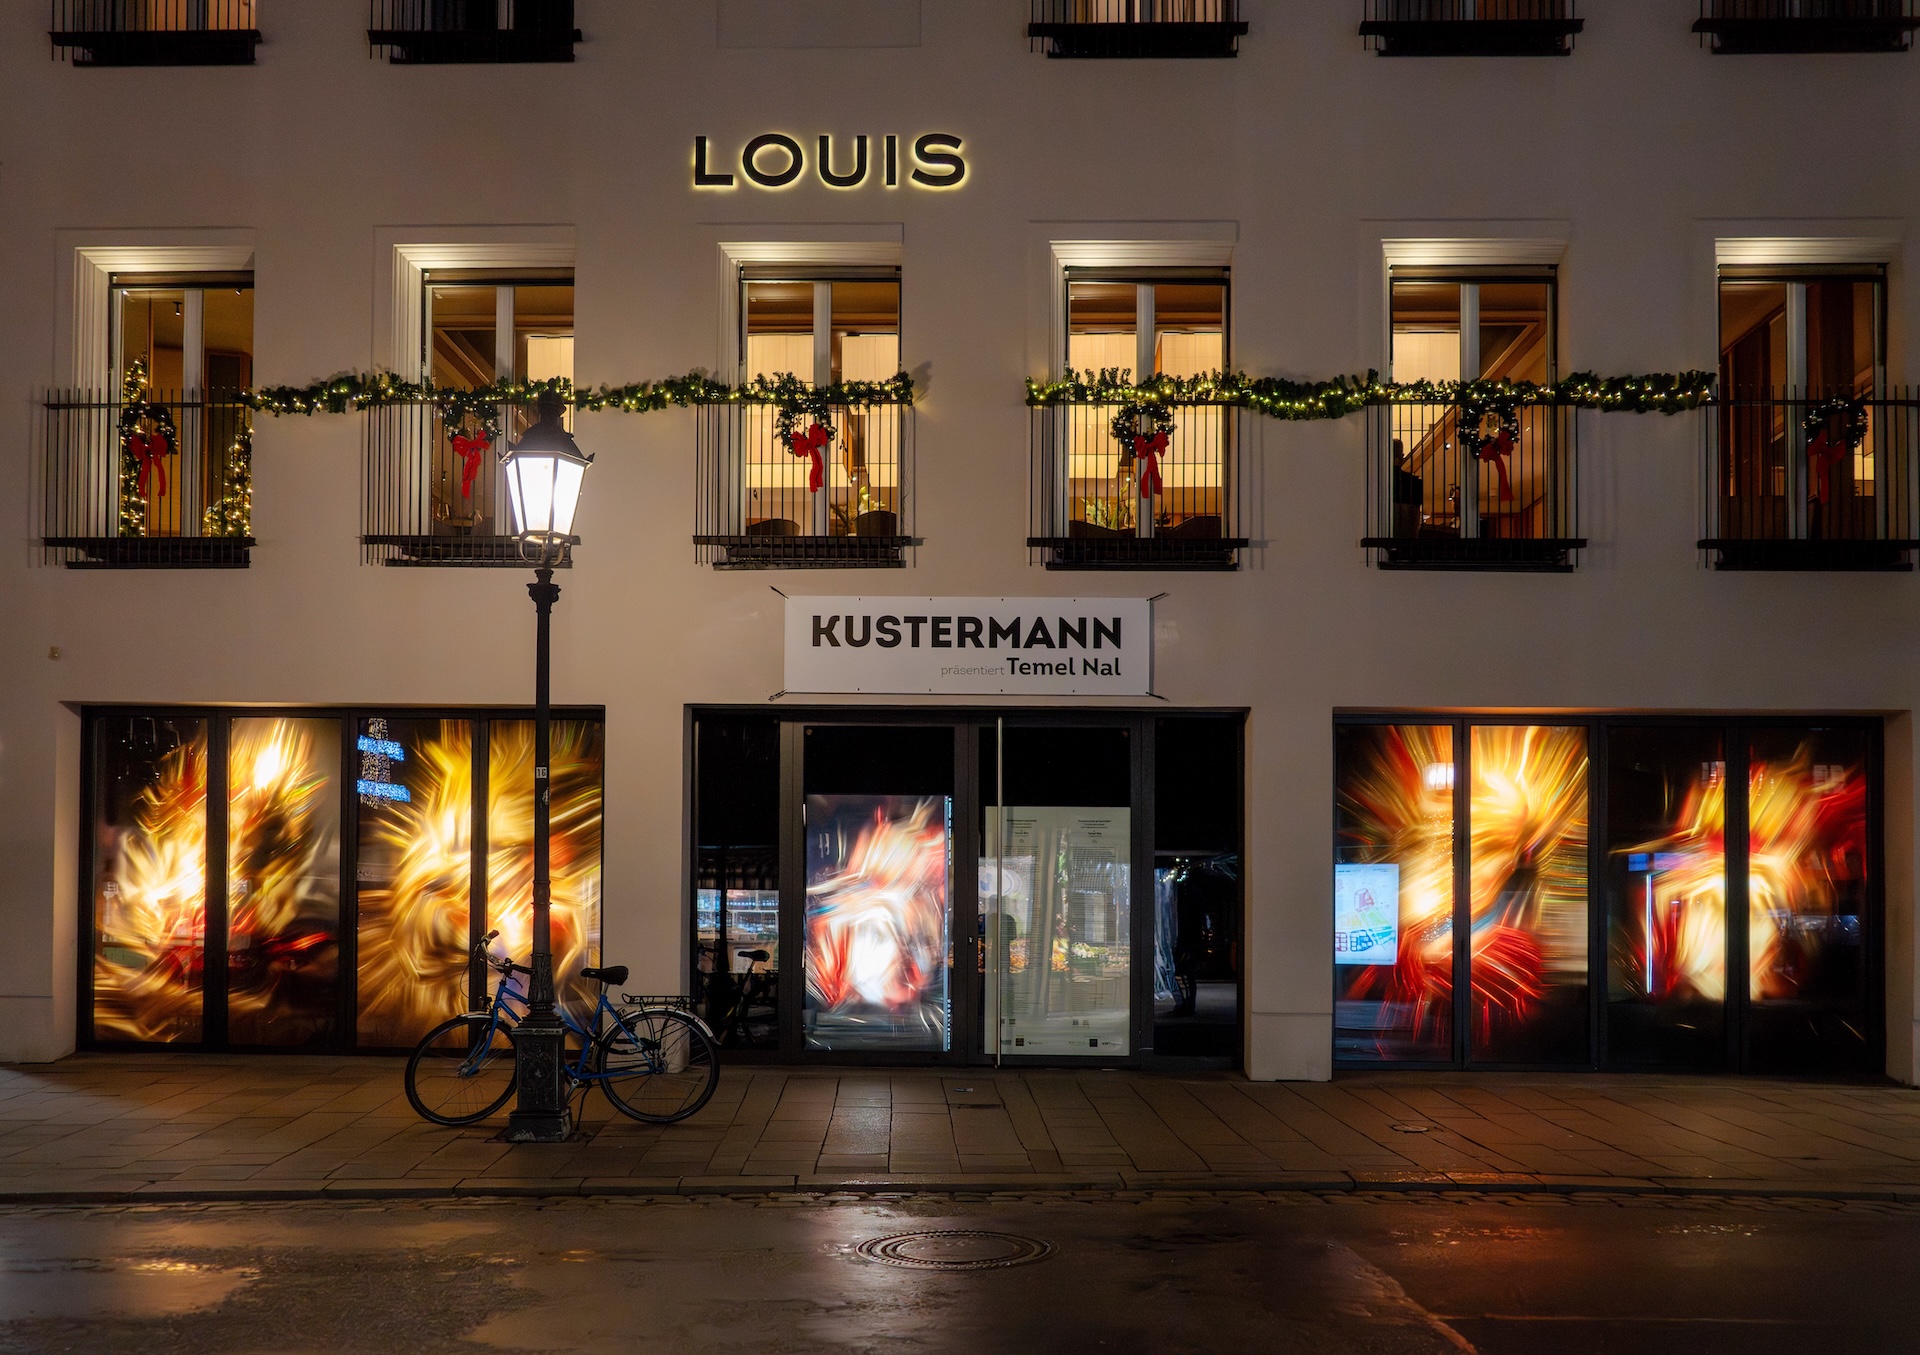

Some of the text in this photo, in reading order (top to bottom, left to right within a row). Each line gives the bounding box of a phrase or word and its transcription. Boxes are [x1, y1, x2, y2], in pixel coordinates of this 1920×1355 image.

[694, 134, 966, 186] LOUIS
[813, 616, 1121, 649] KUSTERMANN
[941, 657, 1121, 678] präsentiert Temel Nal
[537, 768, 546, 777] 16
